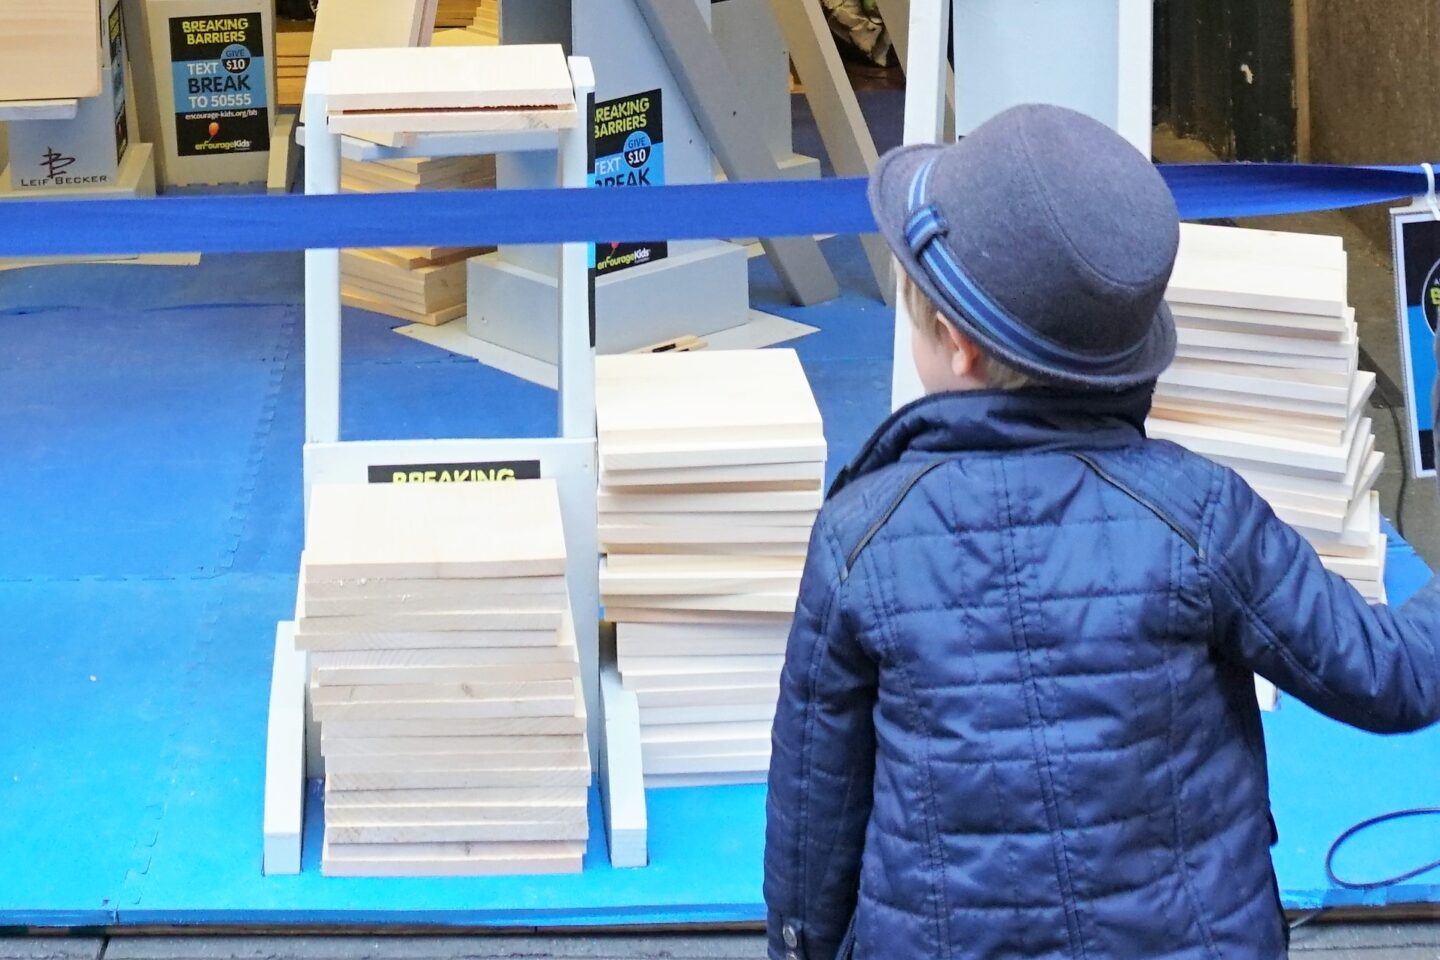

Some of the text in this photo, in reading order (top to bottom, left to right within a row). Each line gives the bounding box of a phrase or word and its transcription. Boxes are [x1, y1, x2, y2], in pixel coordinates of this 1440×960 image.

[182, 18, 248, 33] BREAKING
[186, 31, 246, 45] BARRIERS
[226, 48, 245, 57] GIVE
[187, 62, 219, 76] TEXT
[226, 59, 245, 70] $10
[188, 75, 251, 94] BREAK
[188, 93, 251, 109] TO 50555
[594, 97, 650, 122] REAKING
[628, 136, 646, 149] GIVE
[628, 149, 646, 165] $10
